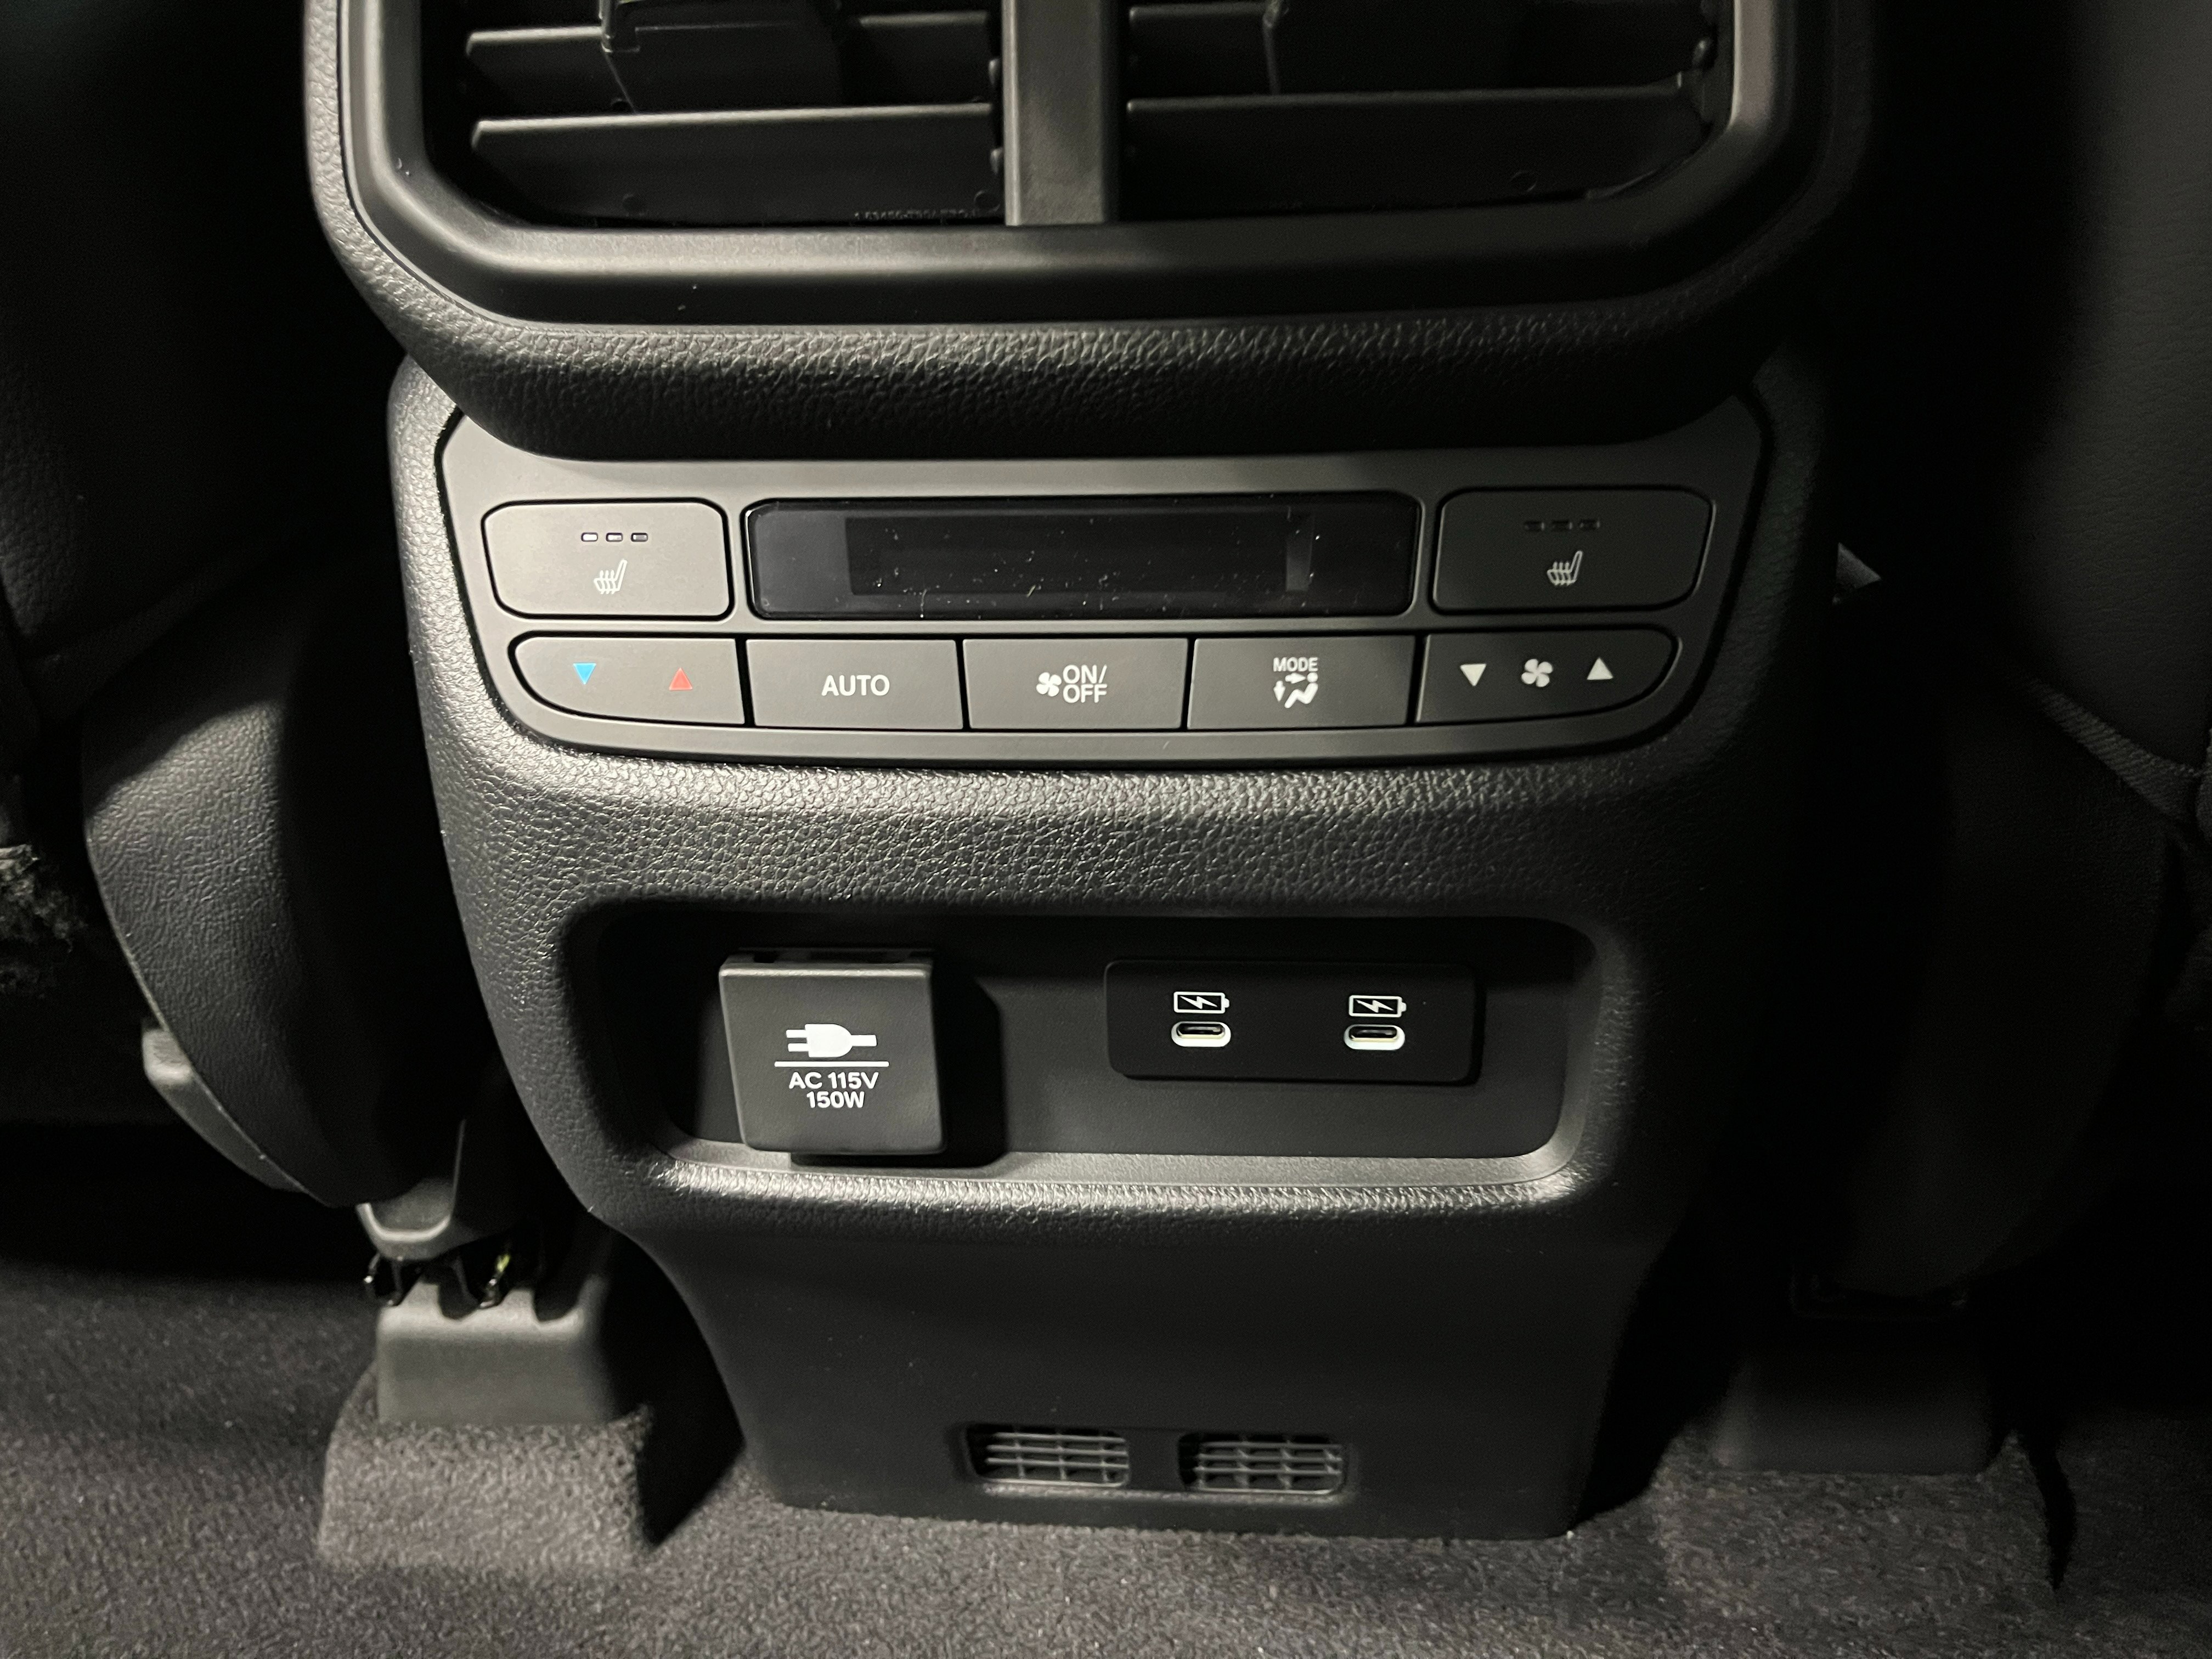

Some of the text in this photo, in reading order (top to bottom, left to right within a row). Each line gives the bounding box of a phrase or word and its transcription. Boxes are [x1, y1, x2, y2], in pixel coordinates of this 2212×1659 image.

[1062, 664, 1107, 684] ON/
[1273, 657, 1318, 672] MODE
[821, 674, 890, 696] AUTO
[1062, 684, 1108, 703] OFF
[788, 1071, 879, 1090] AC 115V
[806, 1091, 865, 1109] 150W
